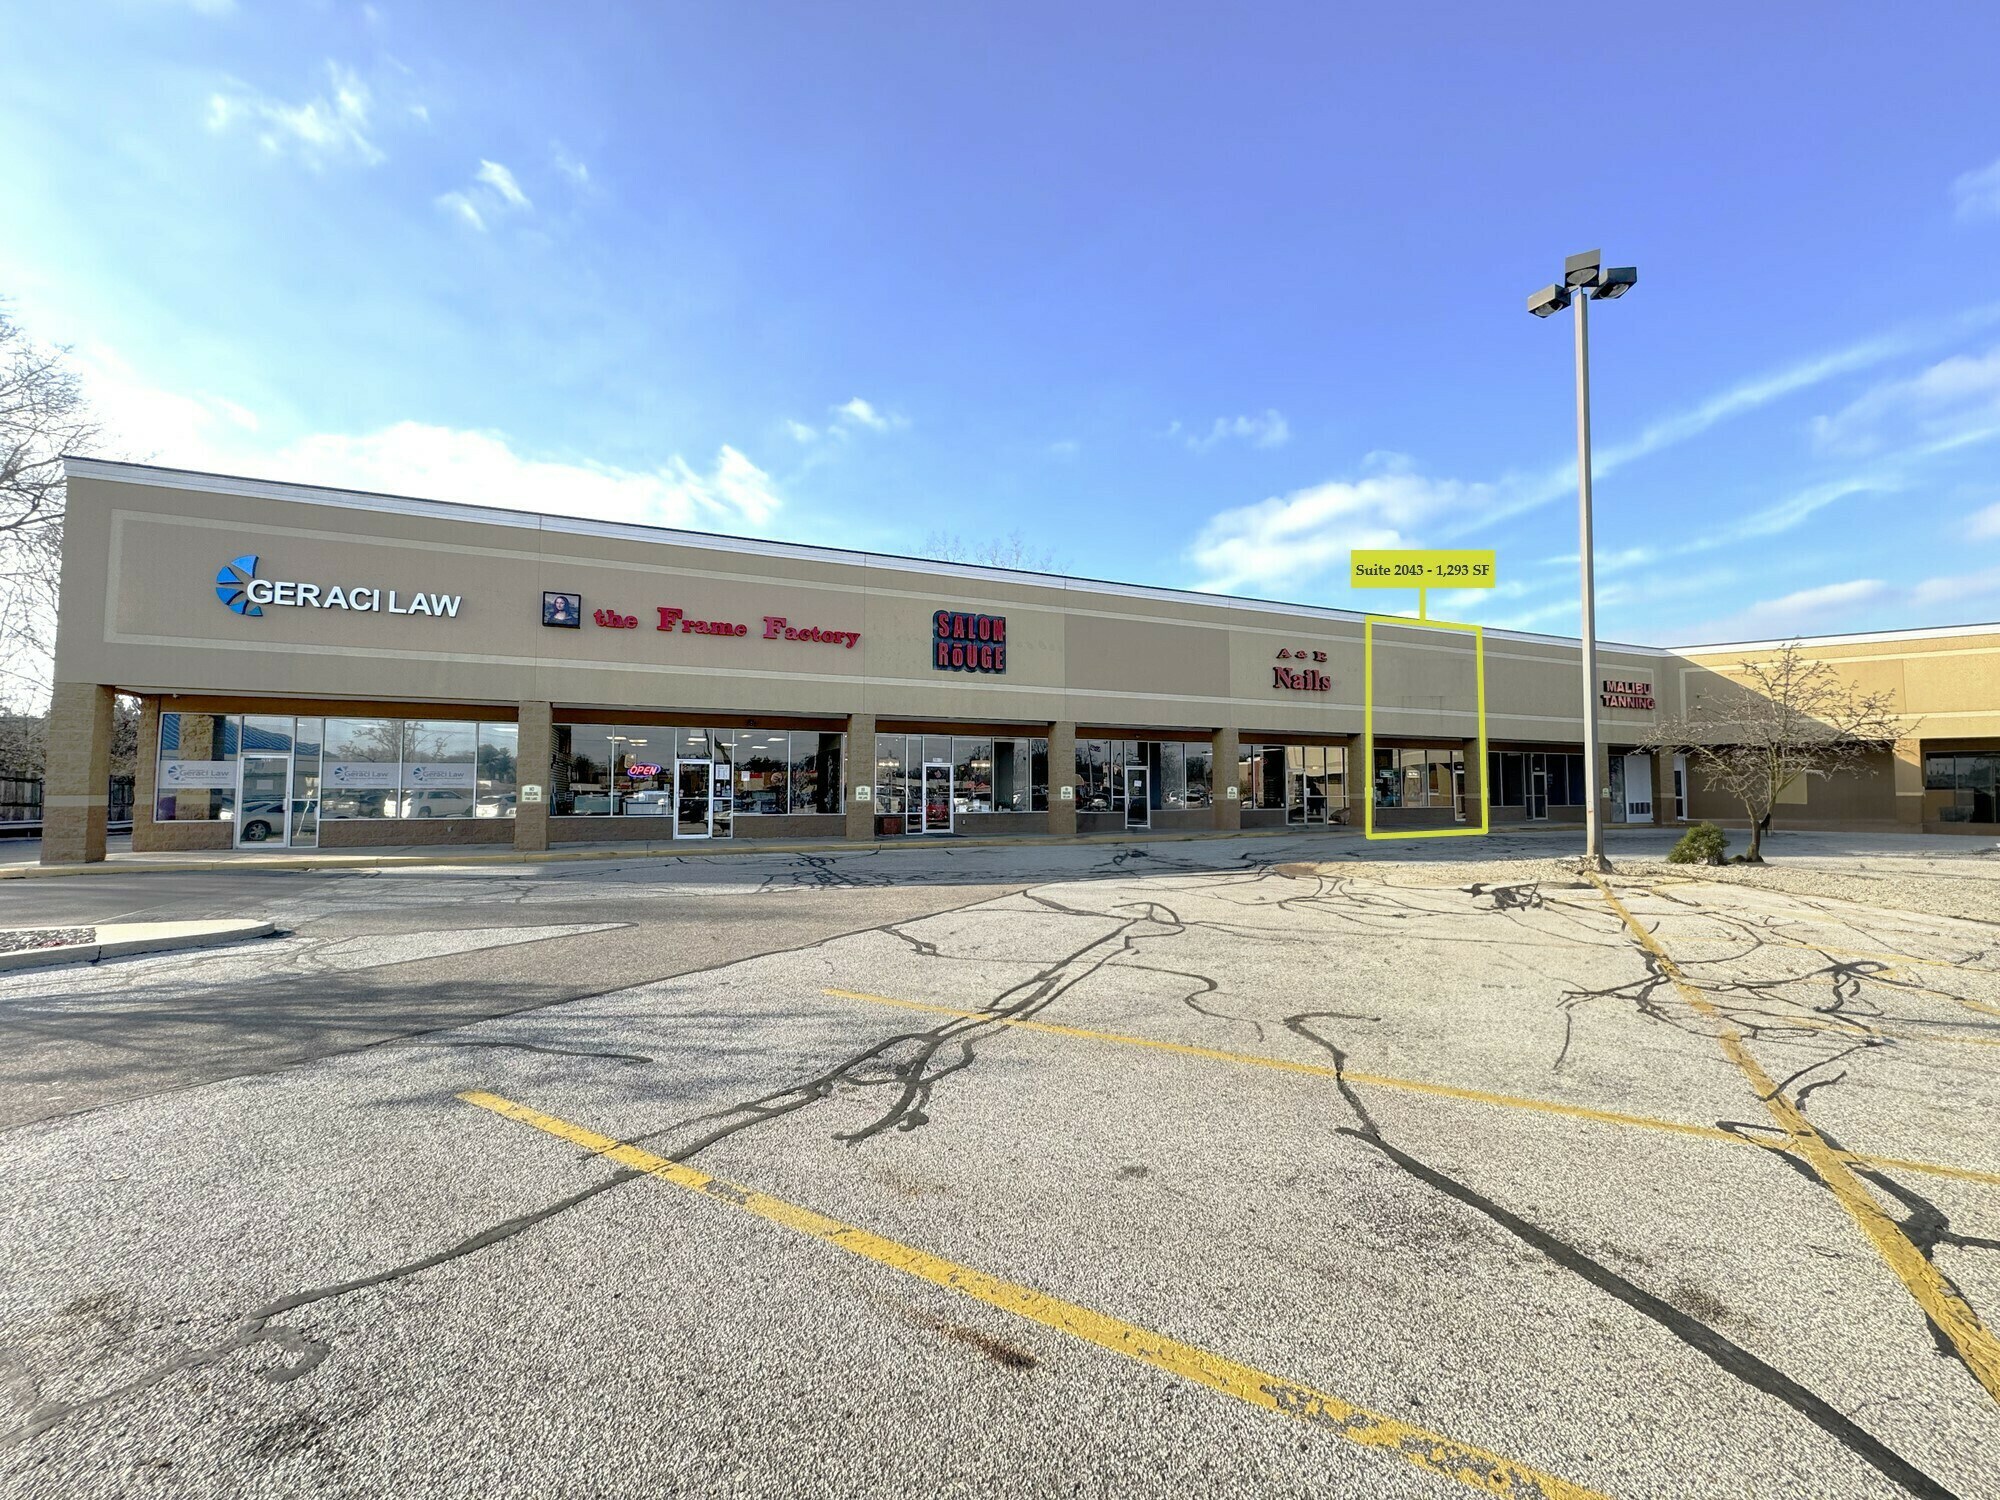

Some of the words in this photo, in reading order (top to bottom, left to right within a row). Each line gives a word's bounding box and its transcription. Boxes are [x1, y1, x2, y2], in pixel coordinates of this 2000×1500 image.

[247, 579, 380, 612] GERACI
[388, 590, 461, 618] LAW
[593, 609, 638, 629] the
[656, 606, 747, 637] Frame
[763, 616, 861, 649] Factory
[938, 613, 1004, 642] SALON
[1276, 648, 1292, 659] A
[1313, 651, 1328, 662] E
[1273, 667, 1331, 691] Nails
[1603, 681, 1651, 695] MALIBU
[1600, 695, 1656, 710] TANNING
[630, 765, 657, 775] OPEN
